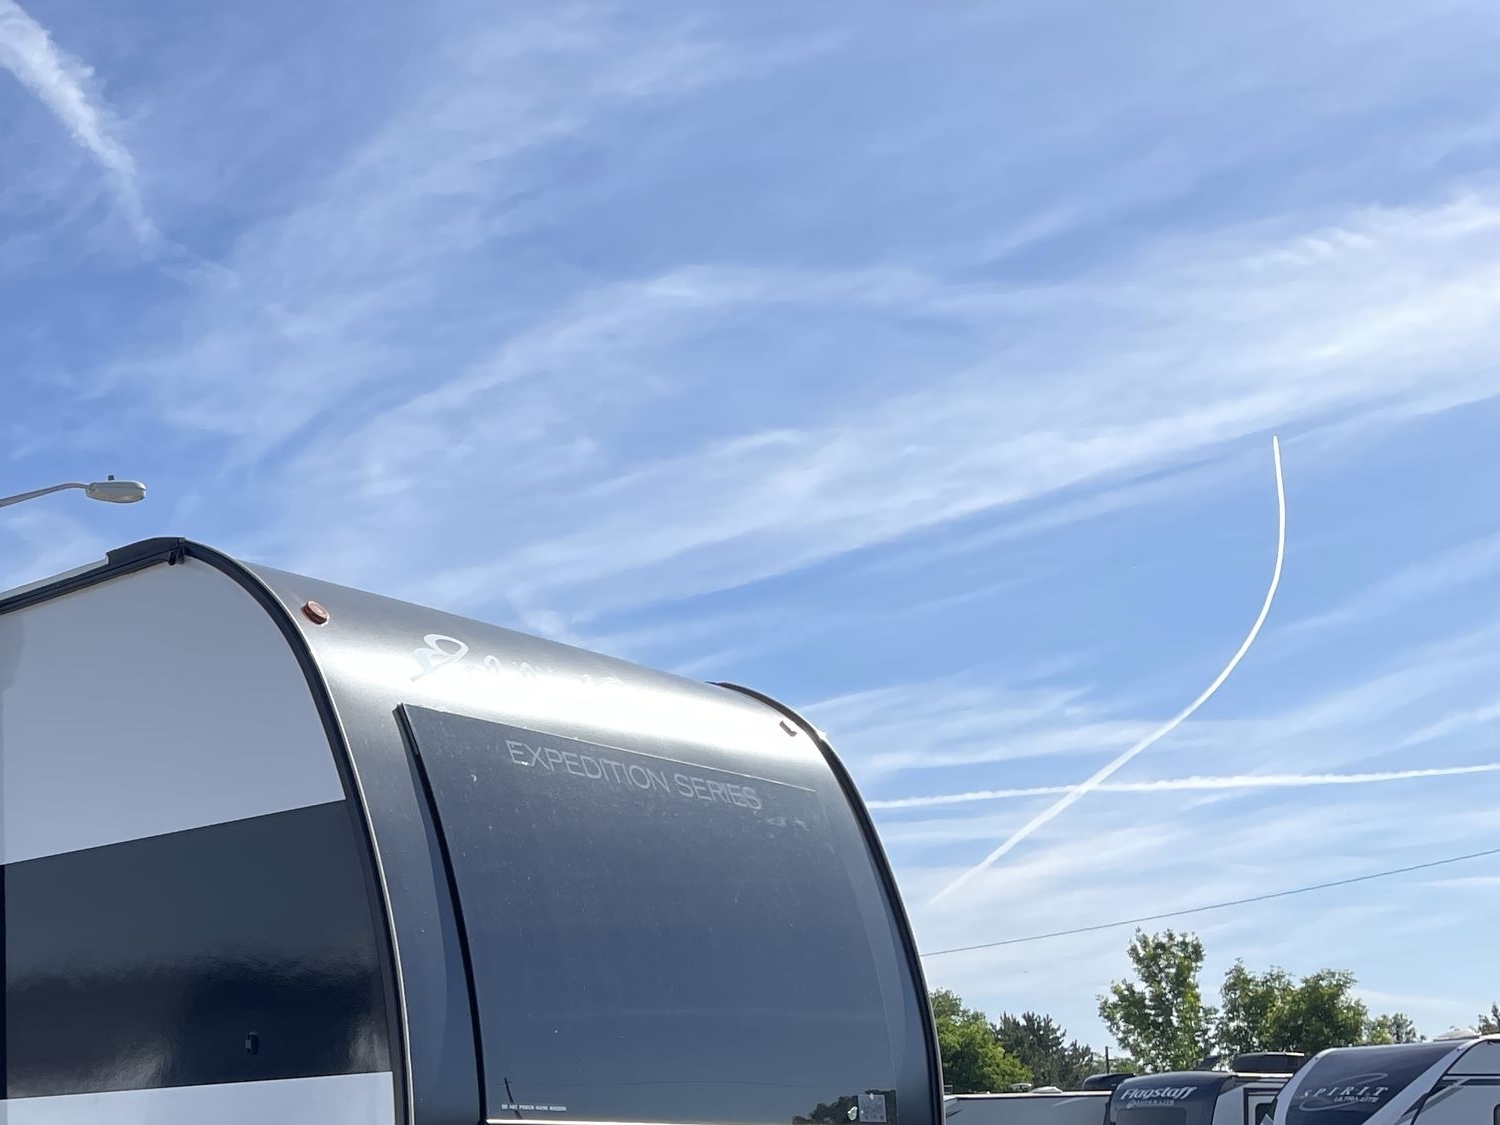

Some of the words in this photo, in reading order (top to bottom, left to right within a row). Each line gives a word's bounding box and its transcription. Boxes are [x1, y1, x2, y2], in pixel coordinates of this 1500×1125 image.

[506, 739, 669, 794] EXPEDITION
[674, 774, 762, 811] SERIES
[1120, 1086, 1198, 1100] Flagstaff
[1301, 1086, 1388, 1099] SPIRIT
